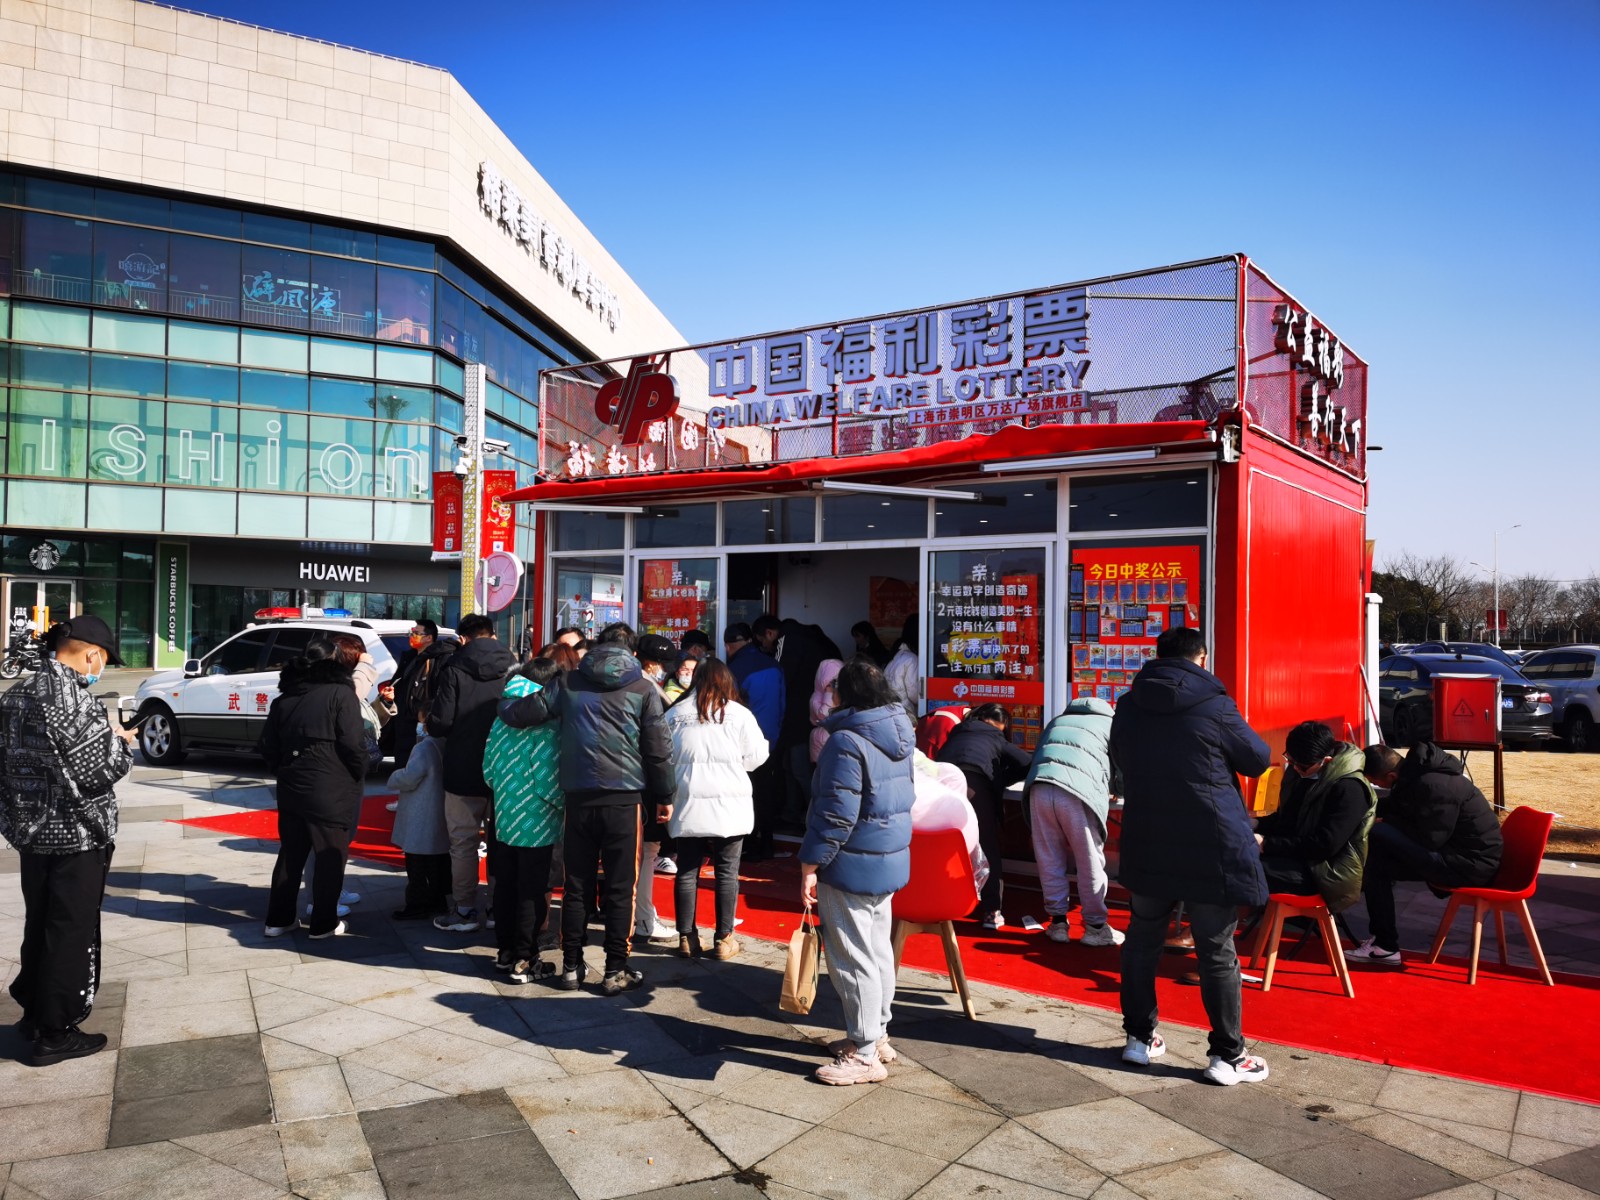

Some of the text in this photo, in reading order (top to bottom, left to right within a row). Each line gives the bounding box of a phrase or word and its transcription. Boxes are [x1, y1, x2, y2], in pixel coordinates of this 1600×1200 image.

[708, 287, 1090, 399] 中国福利彩票
[708, 360, 1090, 429] CHINA WELFARE LOTTERY
[911, 392, 1083, 425] 上海市崇明区万达广场旗舰店
[299, 562, 370, 583] HUAWEI
[1089, 562, 1182, 580] 今日中奖公示
[941, 584, 1028, 597] 幸运数字创造奇迹
[167, 556, 178, 653] STARBUCKS COFFEE
[937, 602, 1033, 617] 2元零花钱创造美妙一生
[952, 620, 1017, 633] 没有什么事情
[228, 692, 269, 712] 武警
